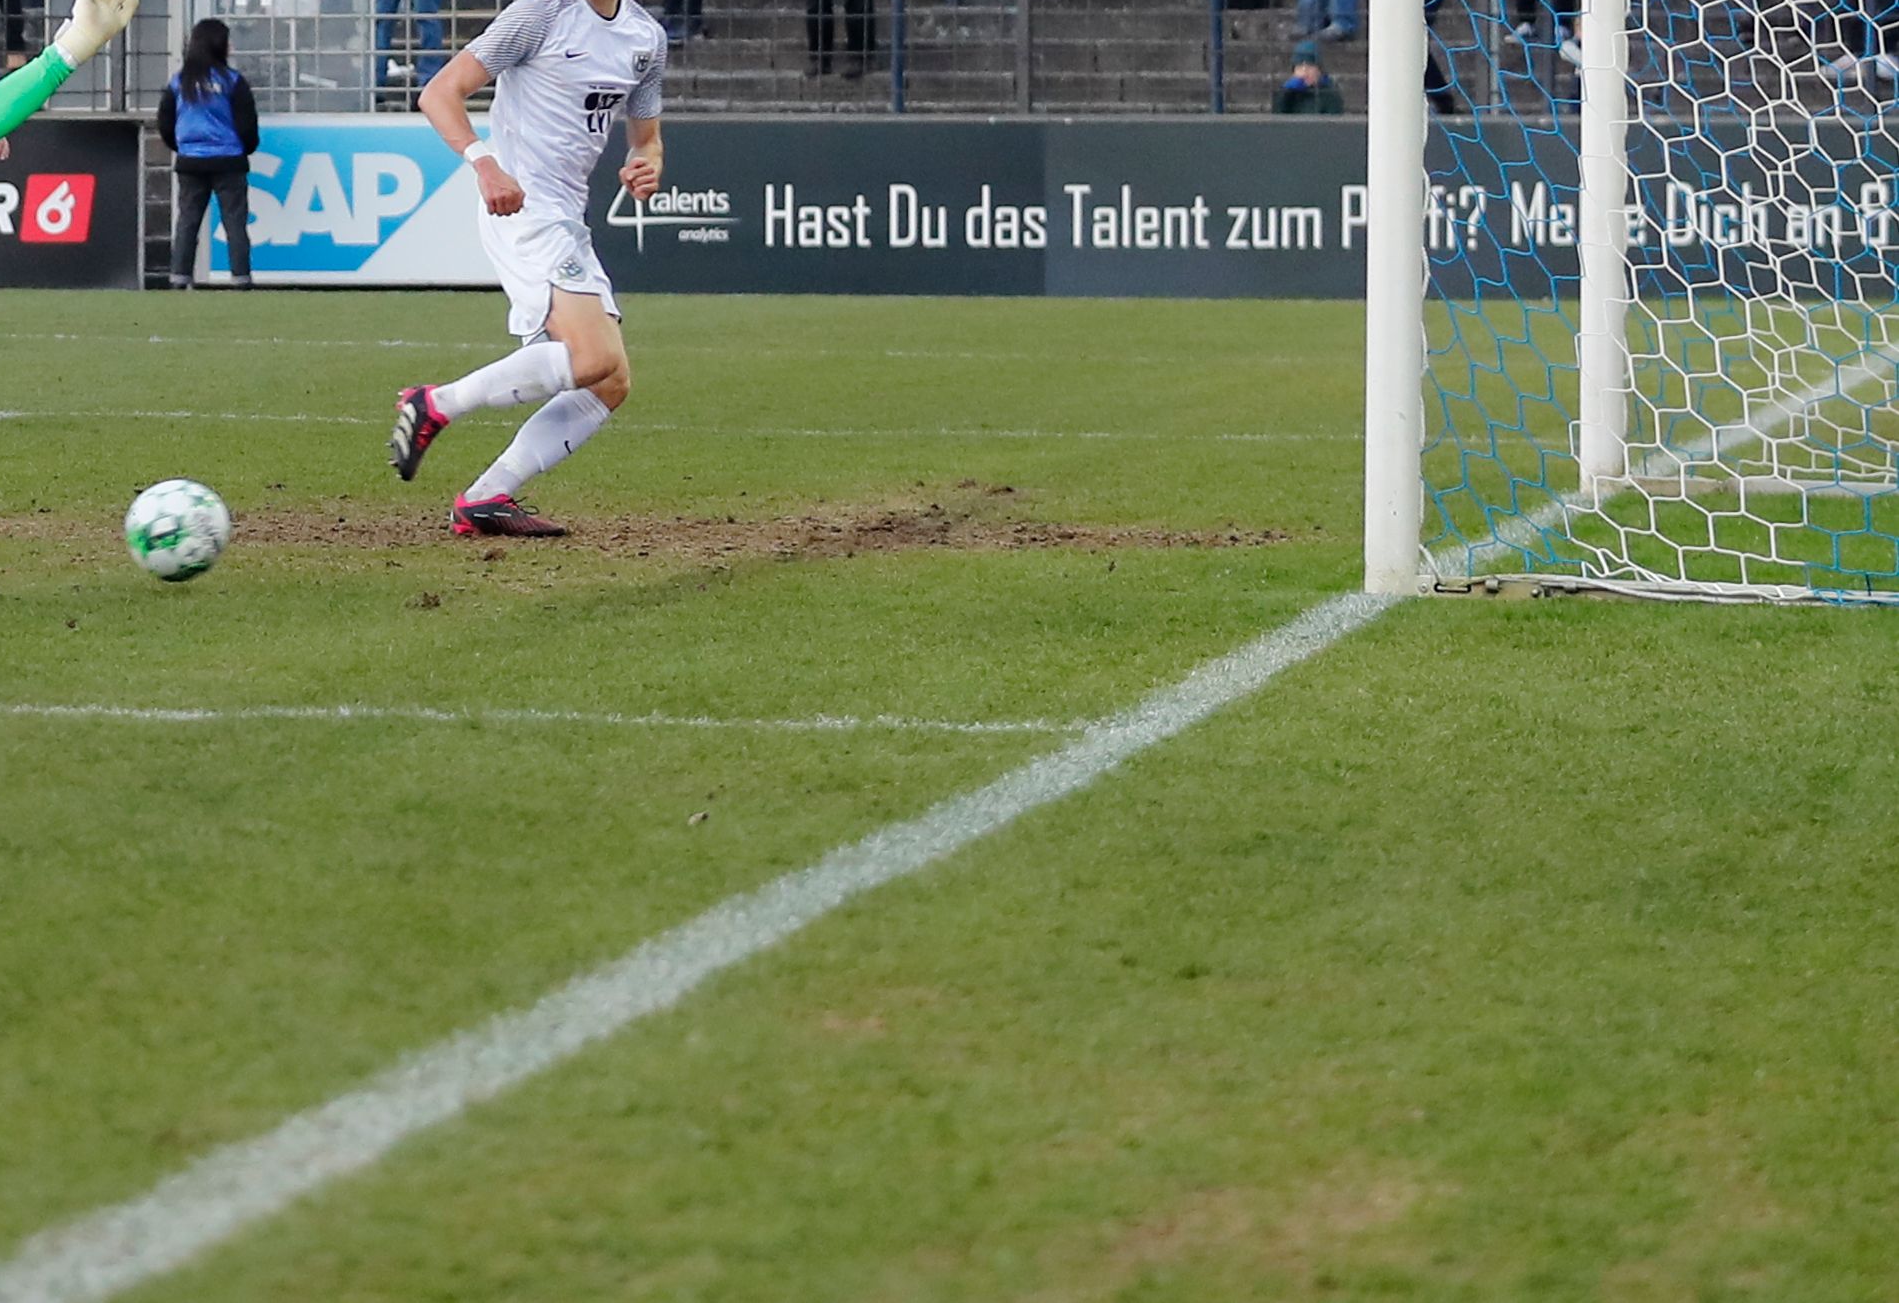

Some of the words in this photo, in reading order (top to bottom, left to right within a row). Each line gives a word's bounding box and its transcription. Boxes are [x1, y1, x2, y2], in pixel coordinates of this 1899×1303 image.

[214, 152, 424, 246] SAP
[764, 183, 871, 248] Hast
[888, 184, 948, 248] Du
[965, 184, 1048, 248] das
[1063, 184, 1211, 249] Talent
[1226, 205, 1324, 249] zum
[1665, 181, 1767, 247] Dich
[1786, 204, 1842, 247] an
